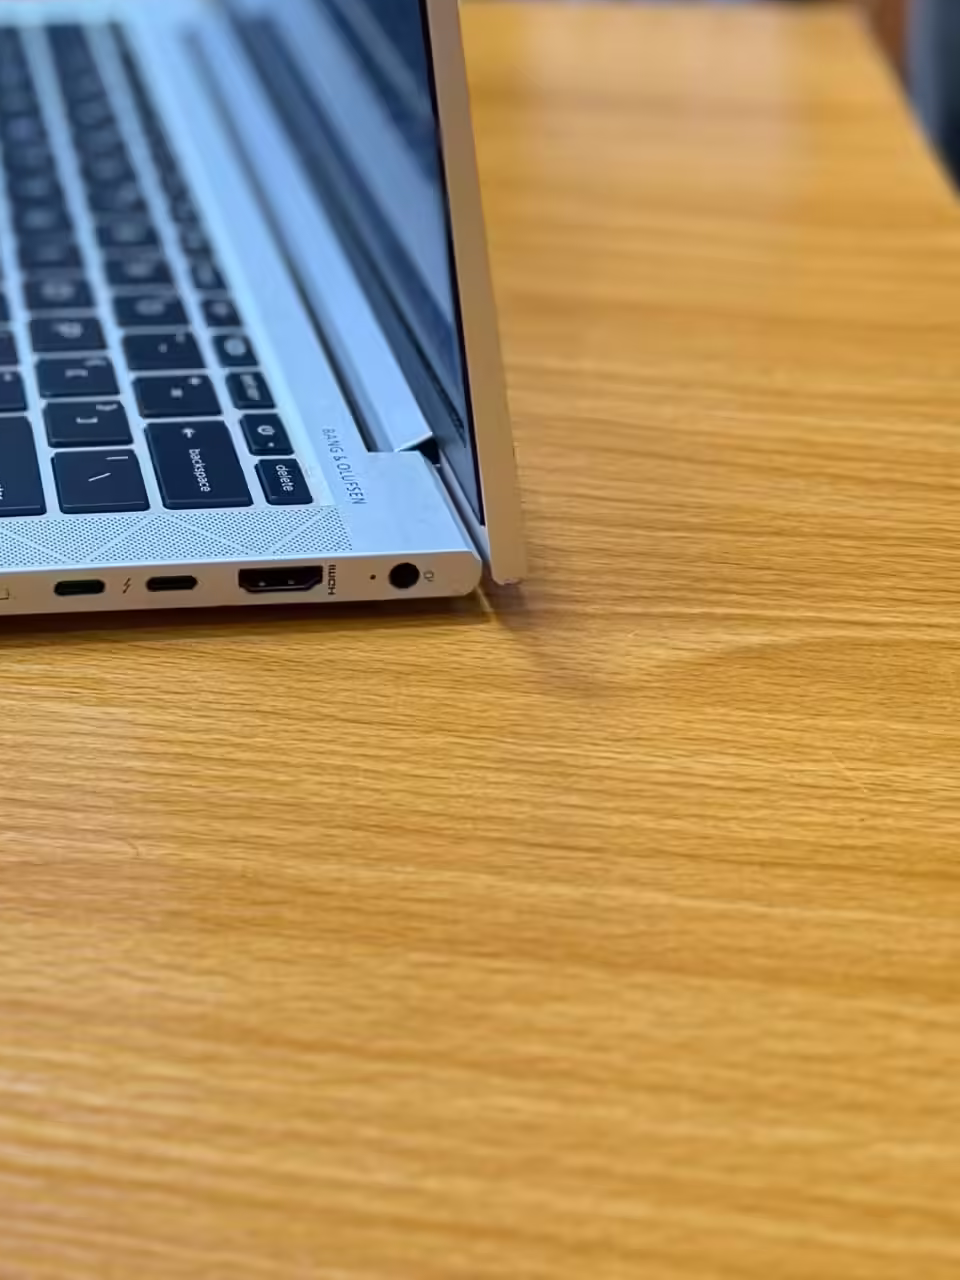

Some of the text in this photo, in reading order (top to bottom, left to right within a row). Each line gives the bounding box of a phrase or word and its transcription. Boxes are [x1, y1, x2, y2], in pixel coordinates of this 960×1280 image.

[188, 447, 211, 493] backspace
[275, 464, 294, 492] delete
[321, 427, 345, 454] BANG
[337, 463, 368, 505] OLUFSEN
[327, 564, 337, 596] HDMI
